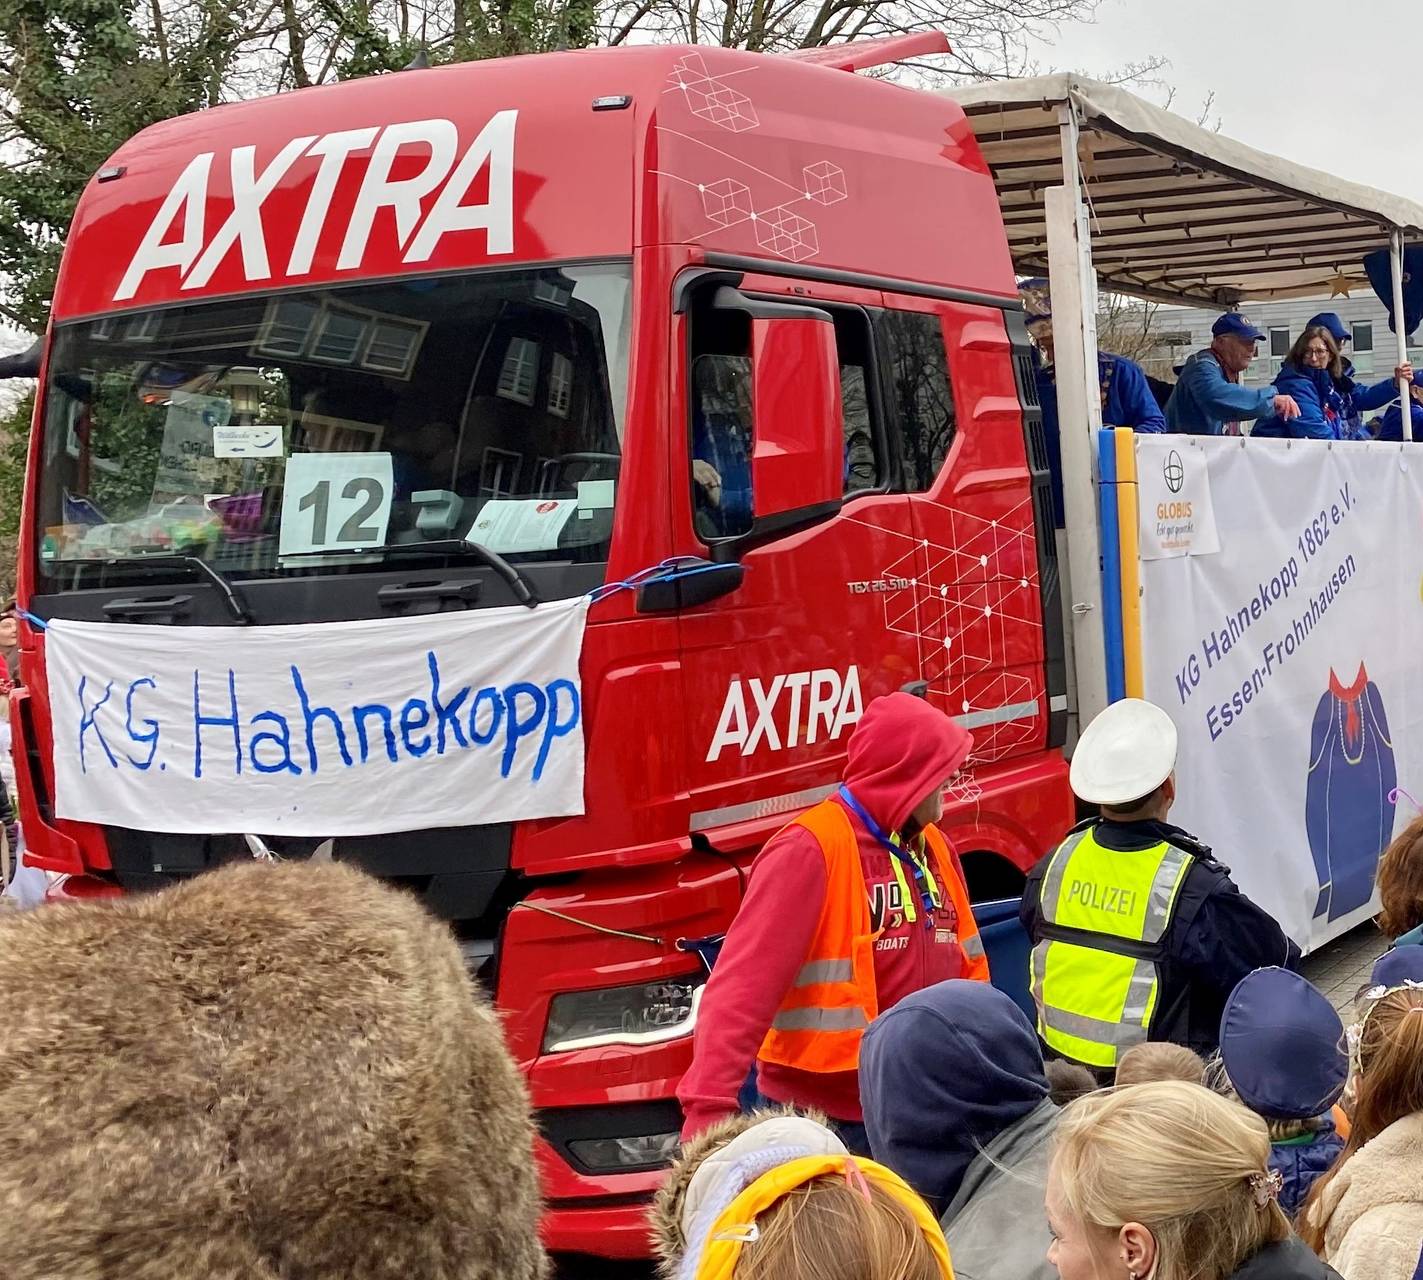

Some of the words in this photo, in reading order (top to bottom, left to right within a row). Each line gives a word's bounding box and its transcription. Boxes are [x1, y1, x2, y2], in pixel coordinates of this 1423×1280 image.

[114, 110, 519, 301] AXTRA
[298, 476, 384, 547] 12
[1157, 502, 1193, 520] GLOBUS
[1175, 653, 1201, 705] KG
[1201, 555, 1299, 669] Hahnekopp
[1298, 510, 1330, 563] 1862
[1331, 481, 1357, 526] e.V.
[1205, 553, 1357, 742] Essen-Frohnhausen
[194, 651, 581, 782] Hahnekopp
[706, 664, 864, 763] AXTRA
[1068, 880, 1137, 917] POLIZEI
